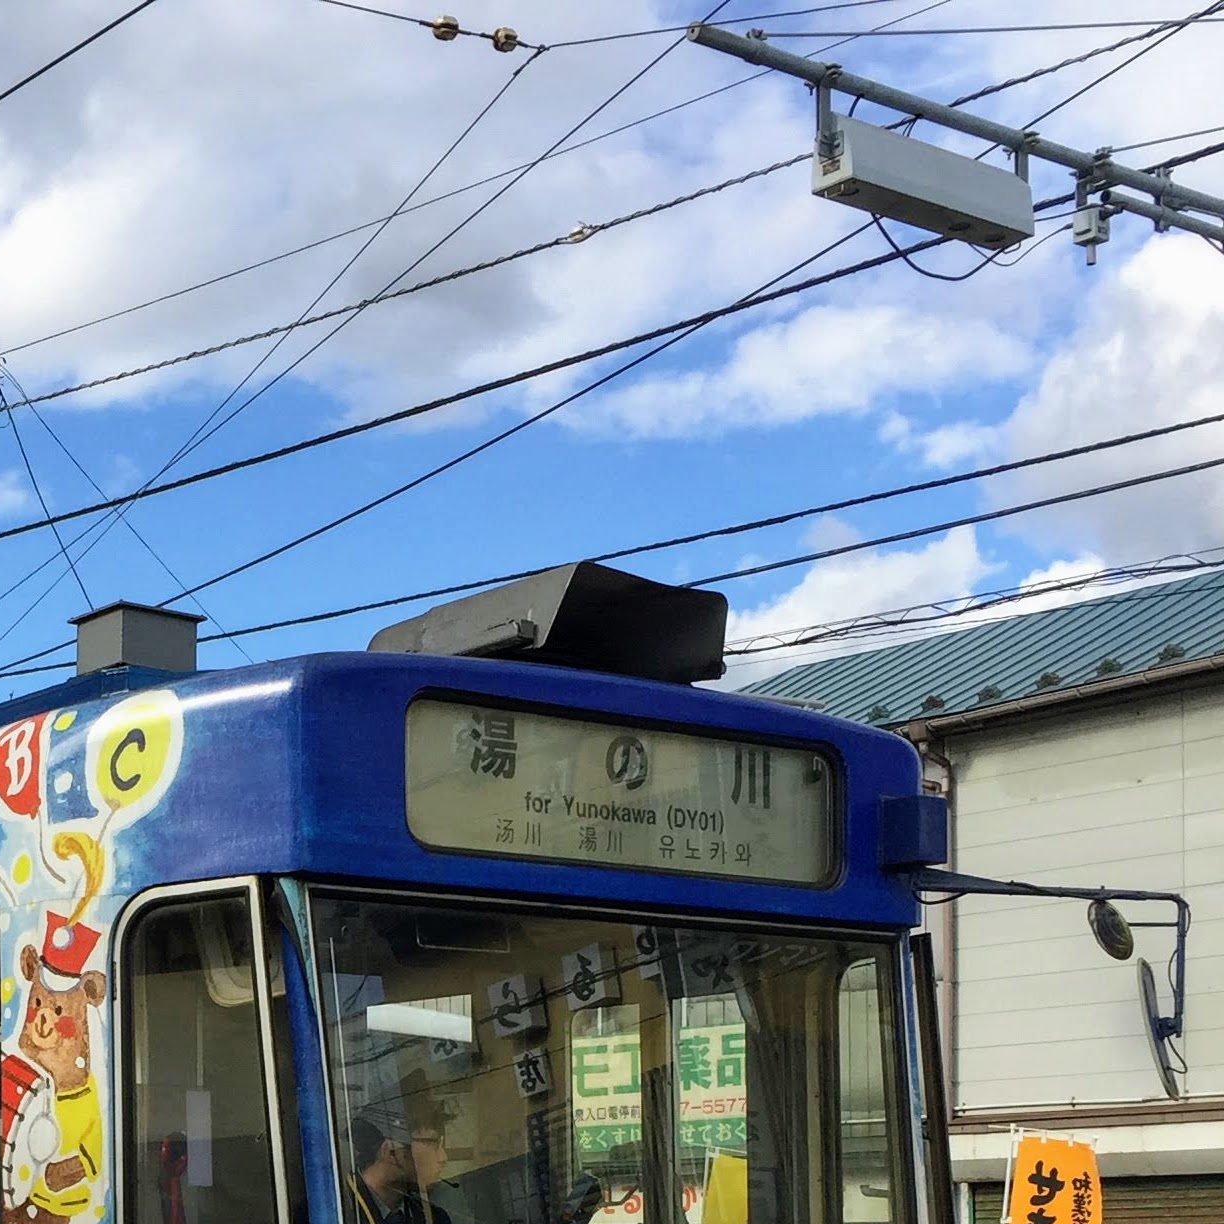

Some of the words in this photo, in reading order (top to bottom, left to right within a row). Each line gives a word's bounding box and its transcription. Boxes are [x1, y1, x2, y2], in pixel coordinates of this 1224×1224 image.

[109, 728, 146, 792] C
[468, 711, 771, 809] 湯の川
[524, 791, 552, 814] for
[562, 795, 657, 826] Yunokawa
[666, 804, 725, 835] (DY01)
[495, 818, 542, 846] 汤川
[578, 825, 623, 854] 湯川
[658, 835, 753, 867] 유노카와
